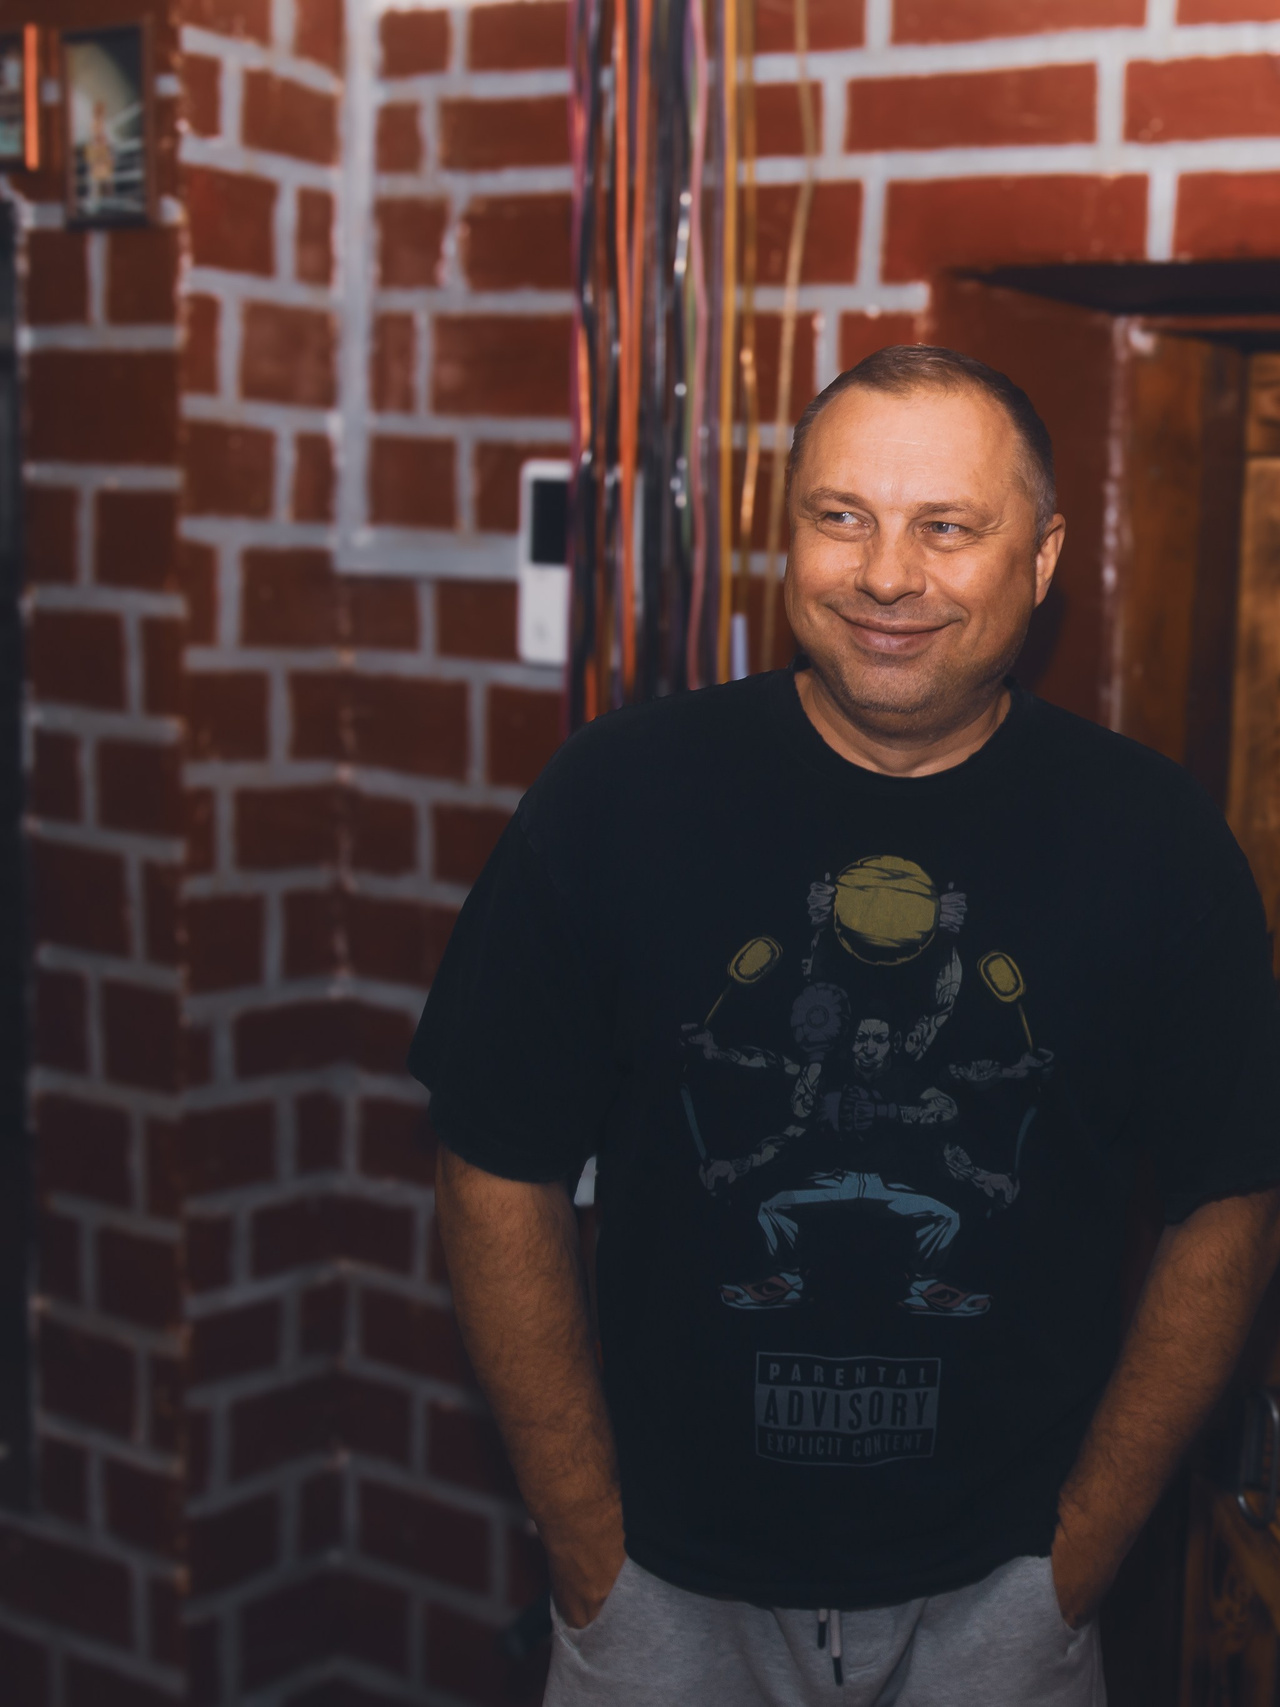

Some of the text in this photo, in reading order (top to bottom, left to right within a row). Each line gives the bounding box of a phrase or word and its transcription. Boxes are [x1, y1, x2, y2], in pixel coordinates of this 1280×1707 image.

[769, 1362, 927, 1386] PARENTAL
[764, 1388, 929, 1431] ADVISORY
[766, 1432, 924, 1458] EXPLICIT CONTENT
